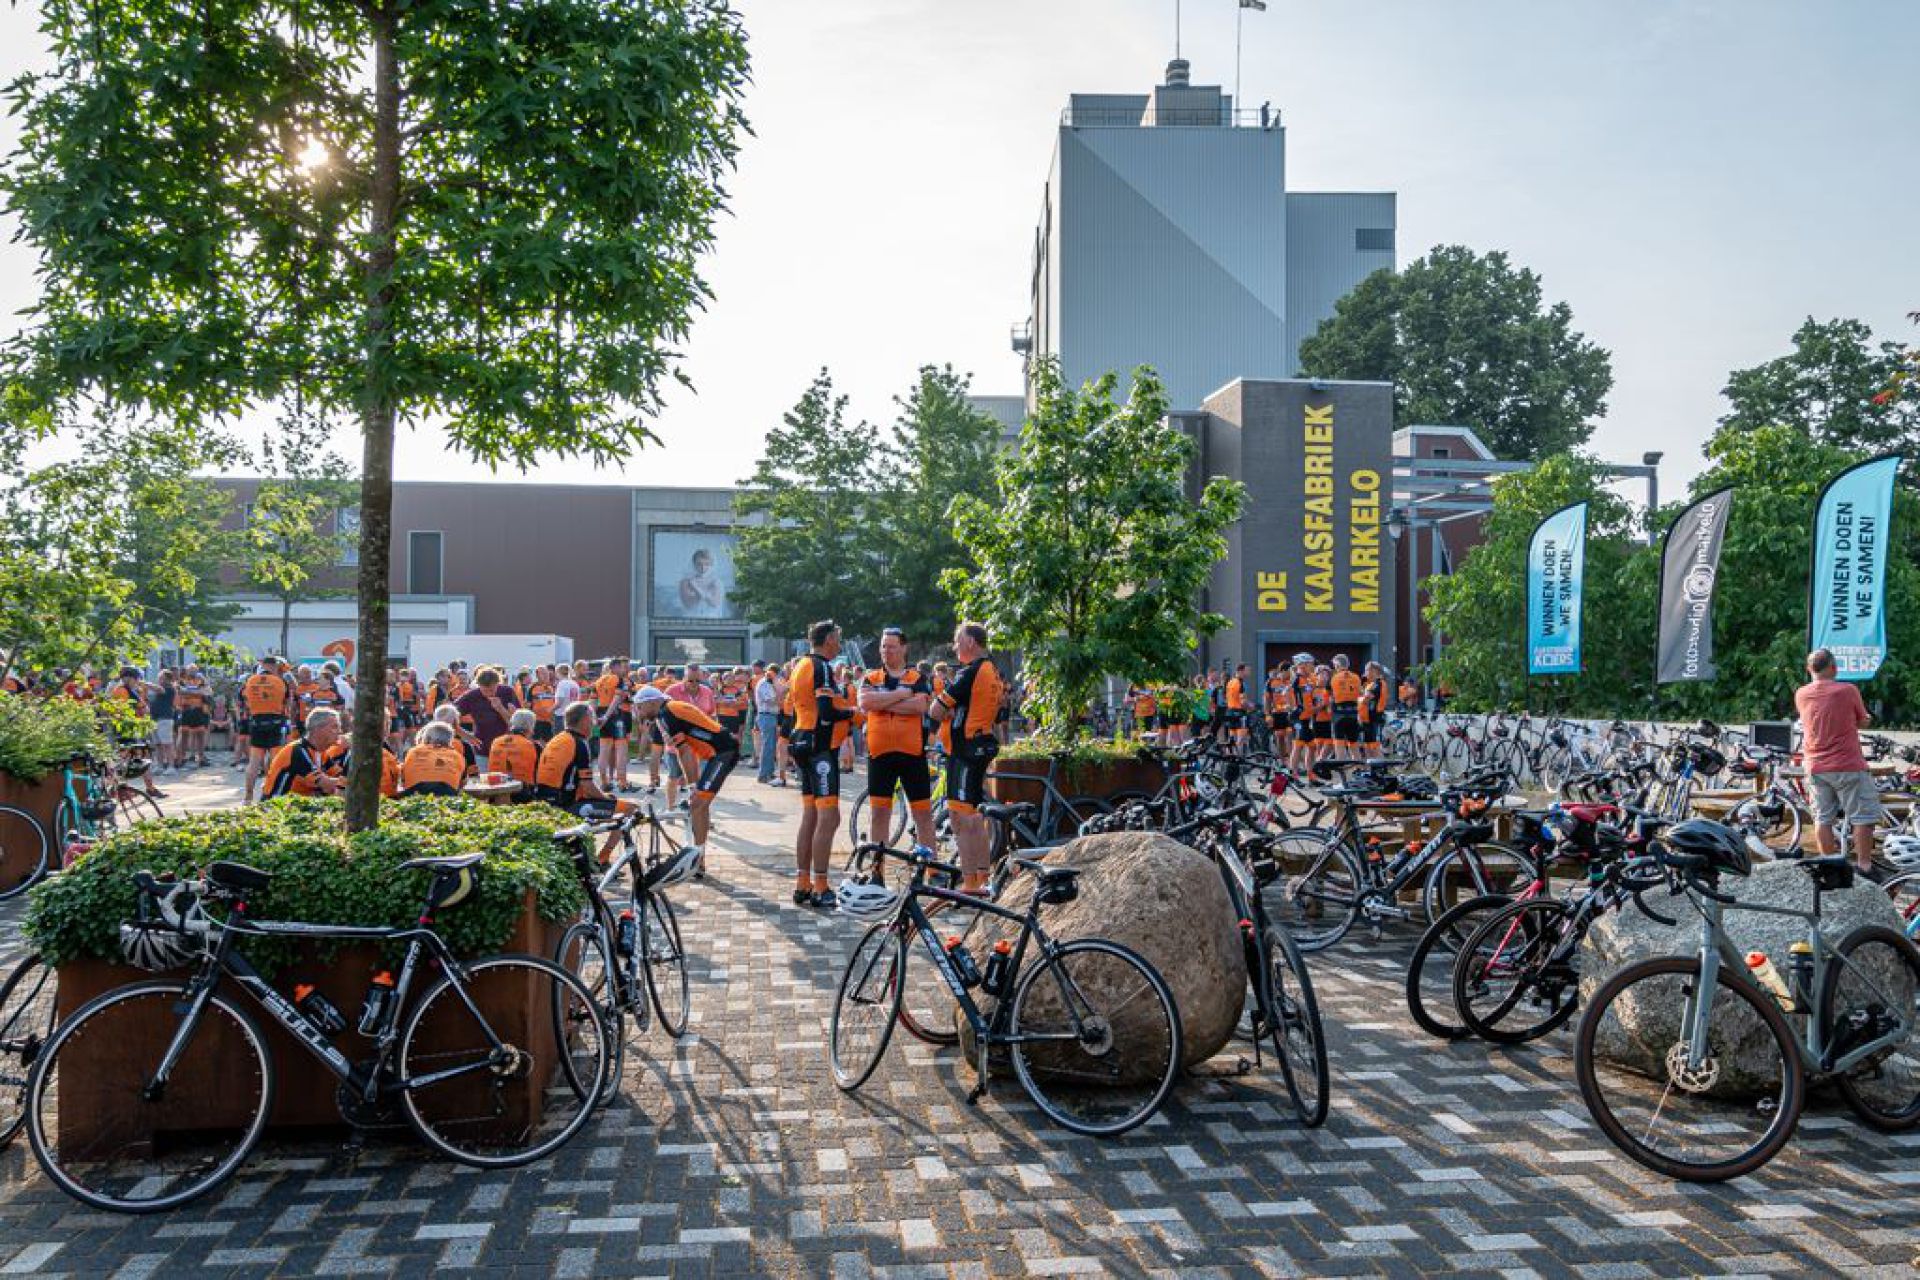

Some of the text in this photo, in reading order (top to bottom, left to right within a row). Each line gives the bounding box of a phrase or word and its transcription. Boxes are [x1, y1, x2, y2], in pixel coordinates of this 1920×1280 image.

[1304, 404, 1334, 612] KAASFABRIEK
[1350, 469, 1381, 612] MARKELO
[1258, 571, 1287, 611] DE
[1543, 540, 1556, 636] WINNEN DOEN
[1560, 604, 1570, 626] WE
[1682, 503, 1715, 678] fotostudio markelo
[1832, 502, 1853, 631] WINNEN DOEN
[1856, 516, 1875, 617] WE SAMEN!
[262, 995, 347, 1066] BULLS
